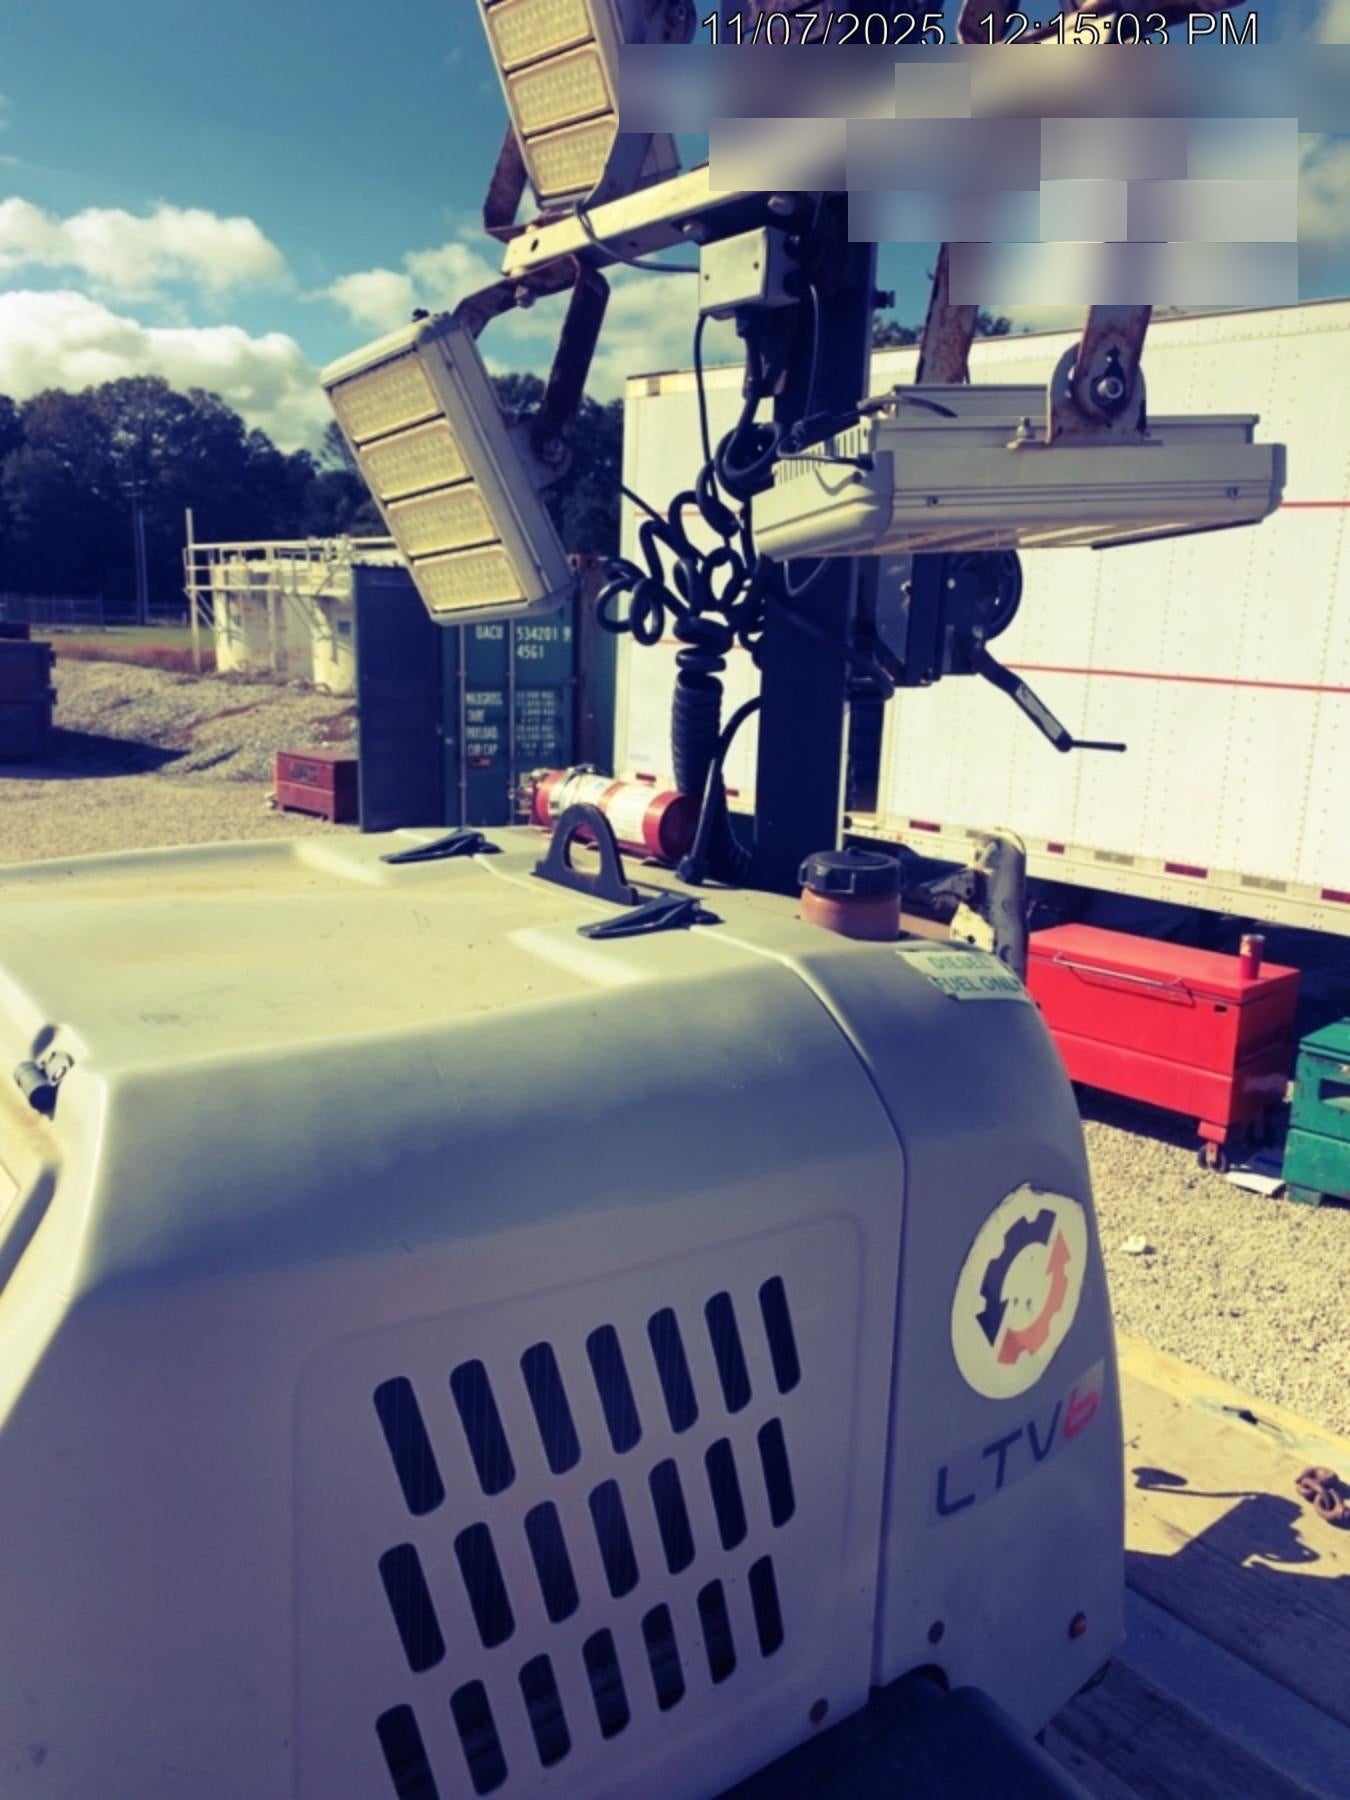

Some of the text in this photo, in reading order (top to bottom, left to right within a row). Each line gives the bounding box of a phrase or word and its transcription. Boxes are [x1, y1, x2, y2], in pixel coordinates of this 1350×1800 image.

[516, 626, 557, 641] 534201
[927, 955, 993, 969] DIESEL
[935, 976, 981, 991] FUEL
